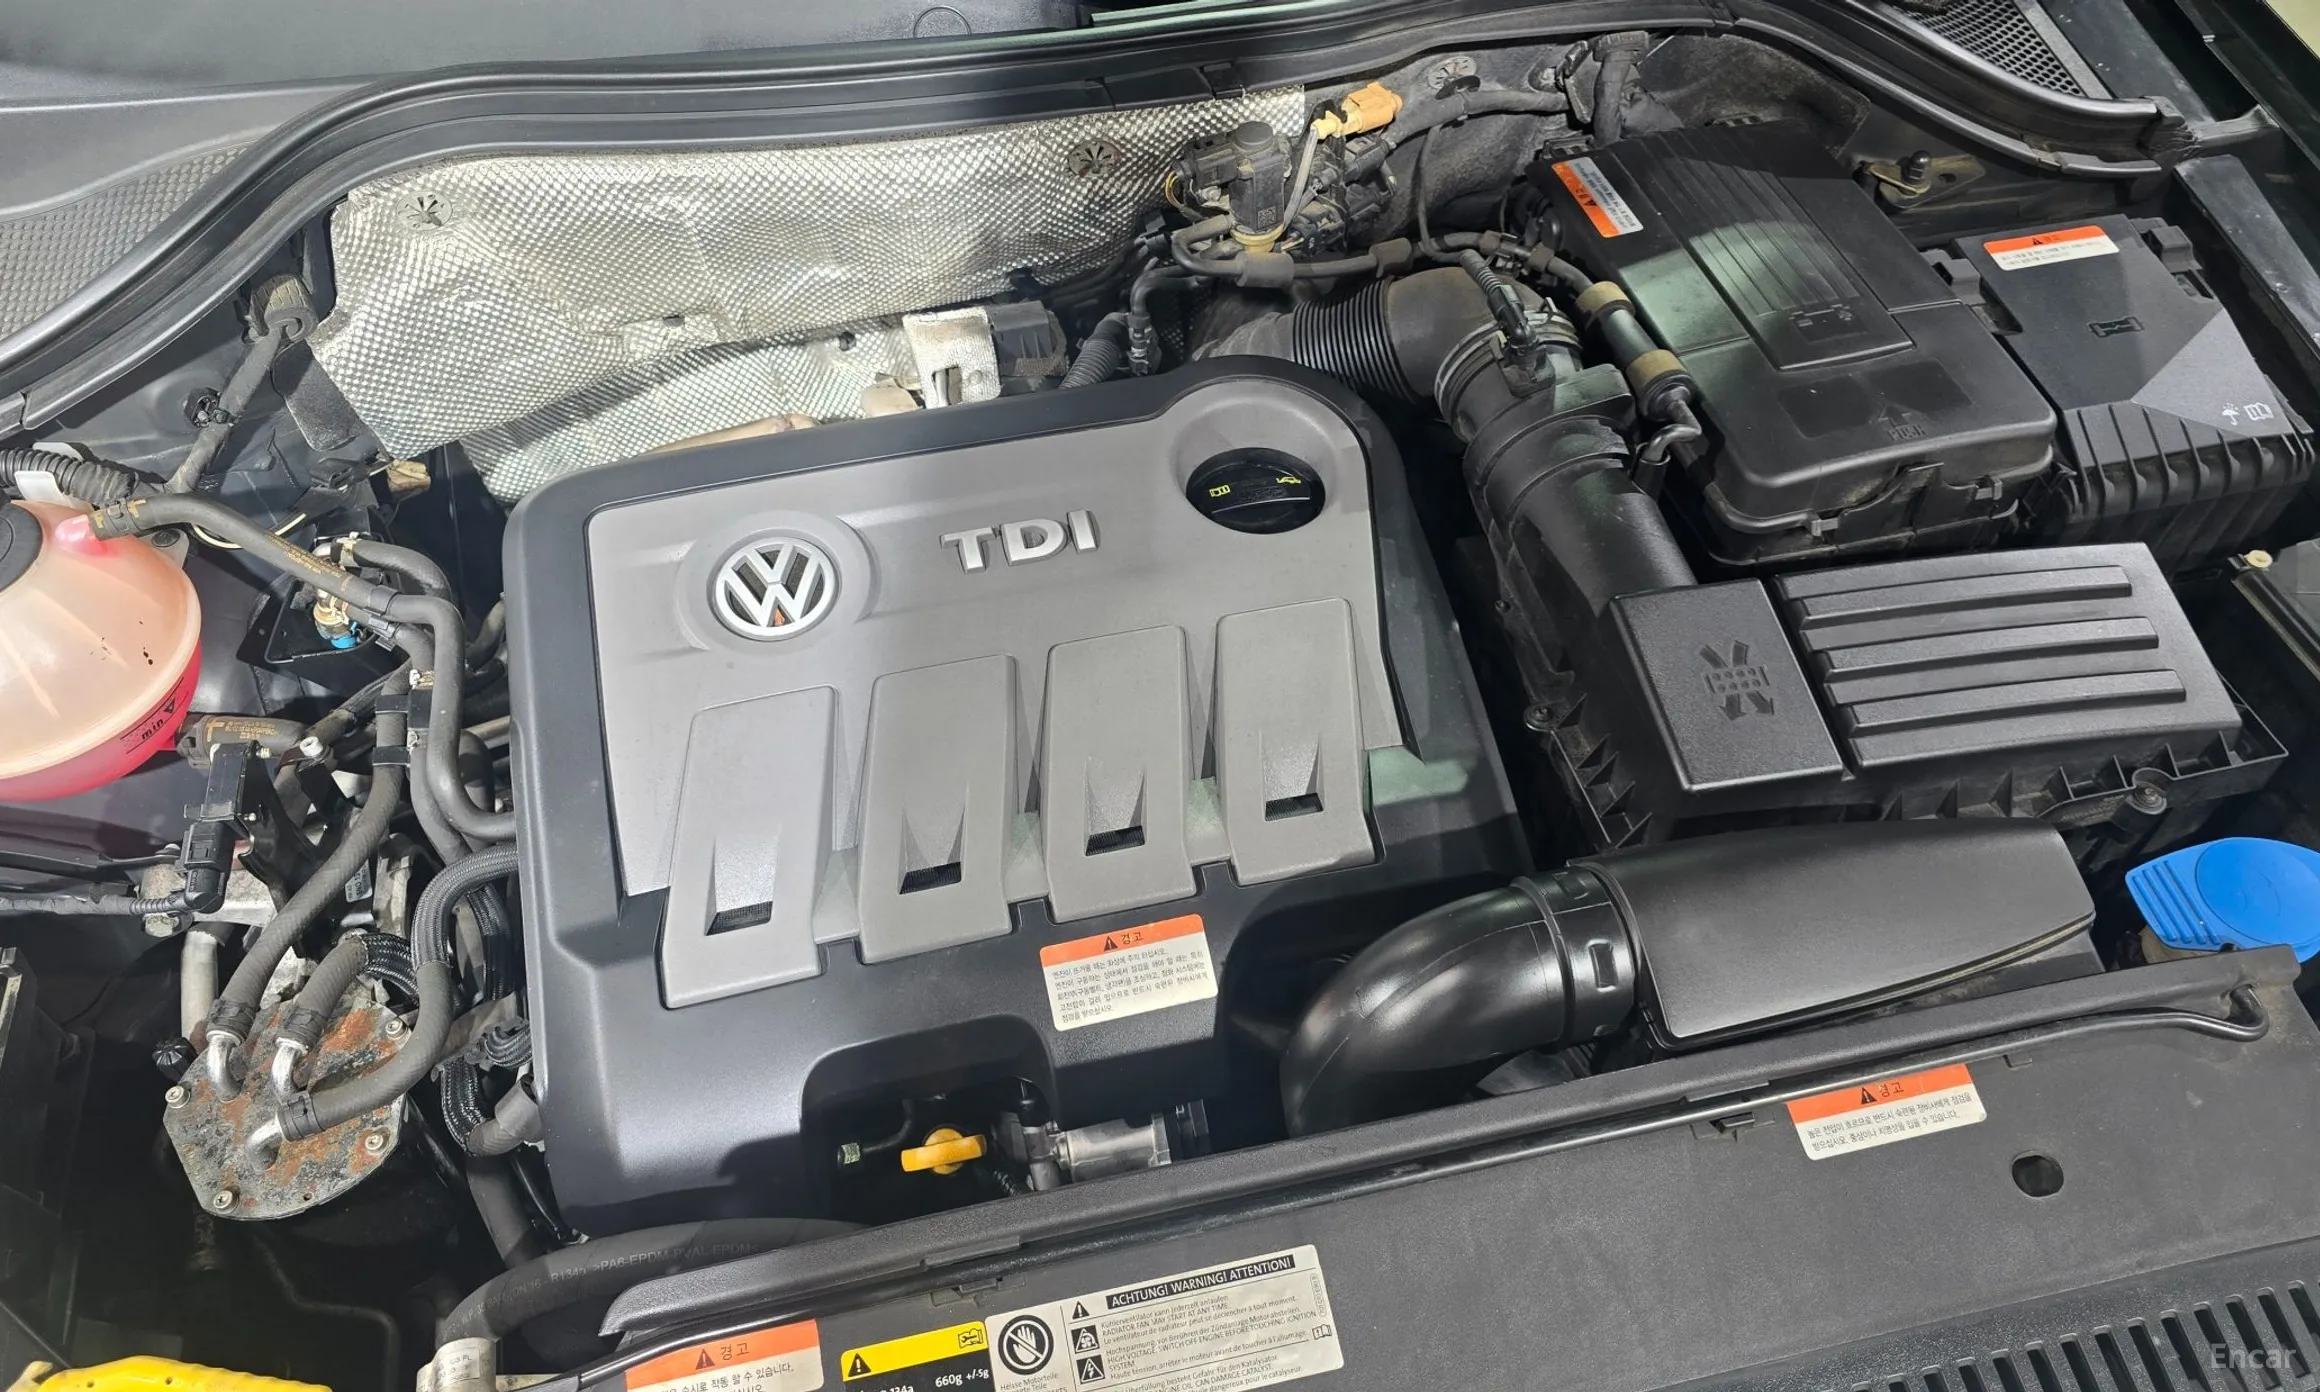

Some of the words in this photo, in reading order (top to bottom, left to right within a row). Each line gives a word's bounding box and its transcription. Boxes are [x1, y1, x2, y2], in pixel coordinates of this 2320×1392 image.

[940, 509, 1099, 574] TDI
[142, 719, 164, 740] min
[1121, 931, 1143, 945] 경고
[1879, 1080, 1903, 1097] 경고
[1111, 1285, 1168, 1306] ACHTUNG!
[1171, 1271, 1227, 1293] WARNING!
[1229, 1257, 1290, 1280] ATTENTION!
[1167, 1312, 1186, 1321] START
[720, 1343, 750, 1361] 경고
[712, 1376, 729, 1389] 작동
[732, 1373, 741, 1385] 할
[743, 1371, 752, 1382] 수
[756, 1362, 795, 1379] 있습니다.
[935, 1374, 963, 1388] 660g
[966, 1368, 990, 1380] +/-5g
